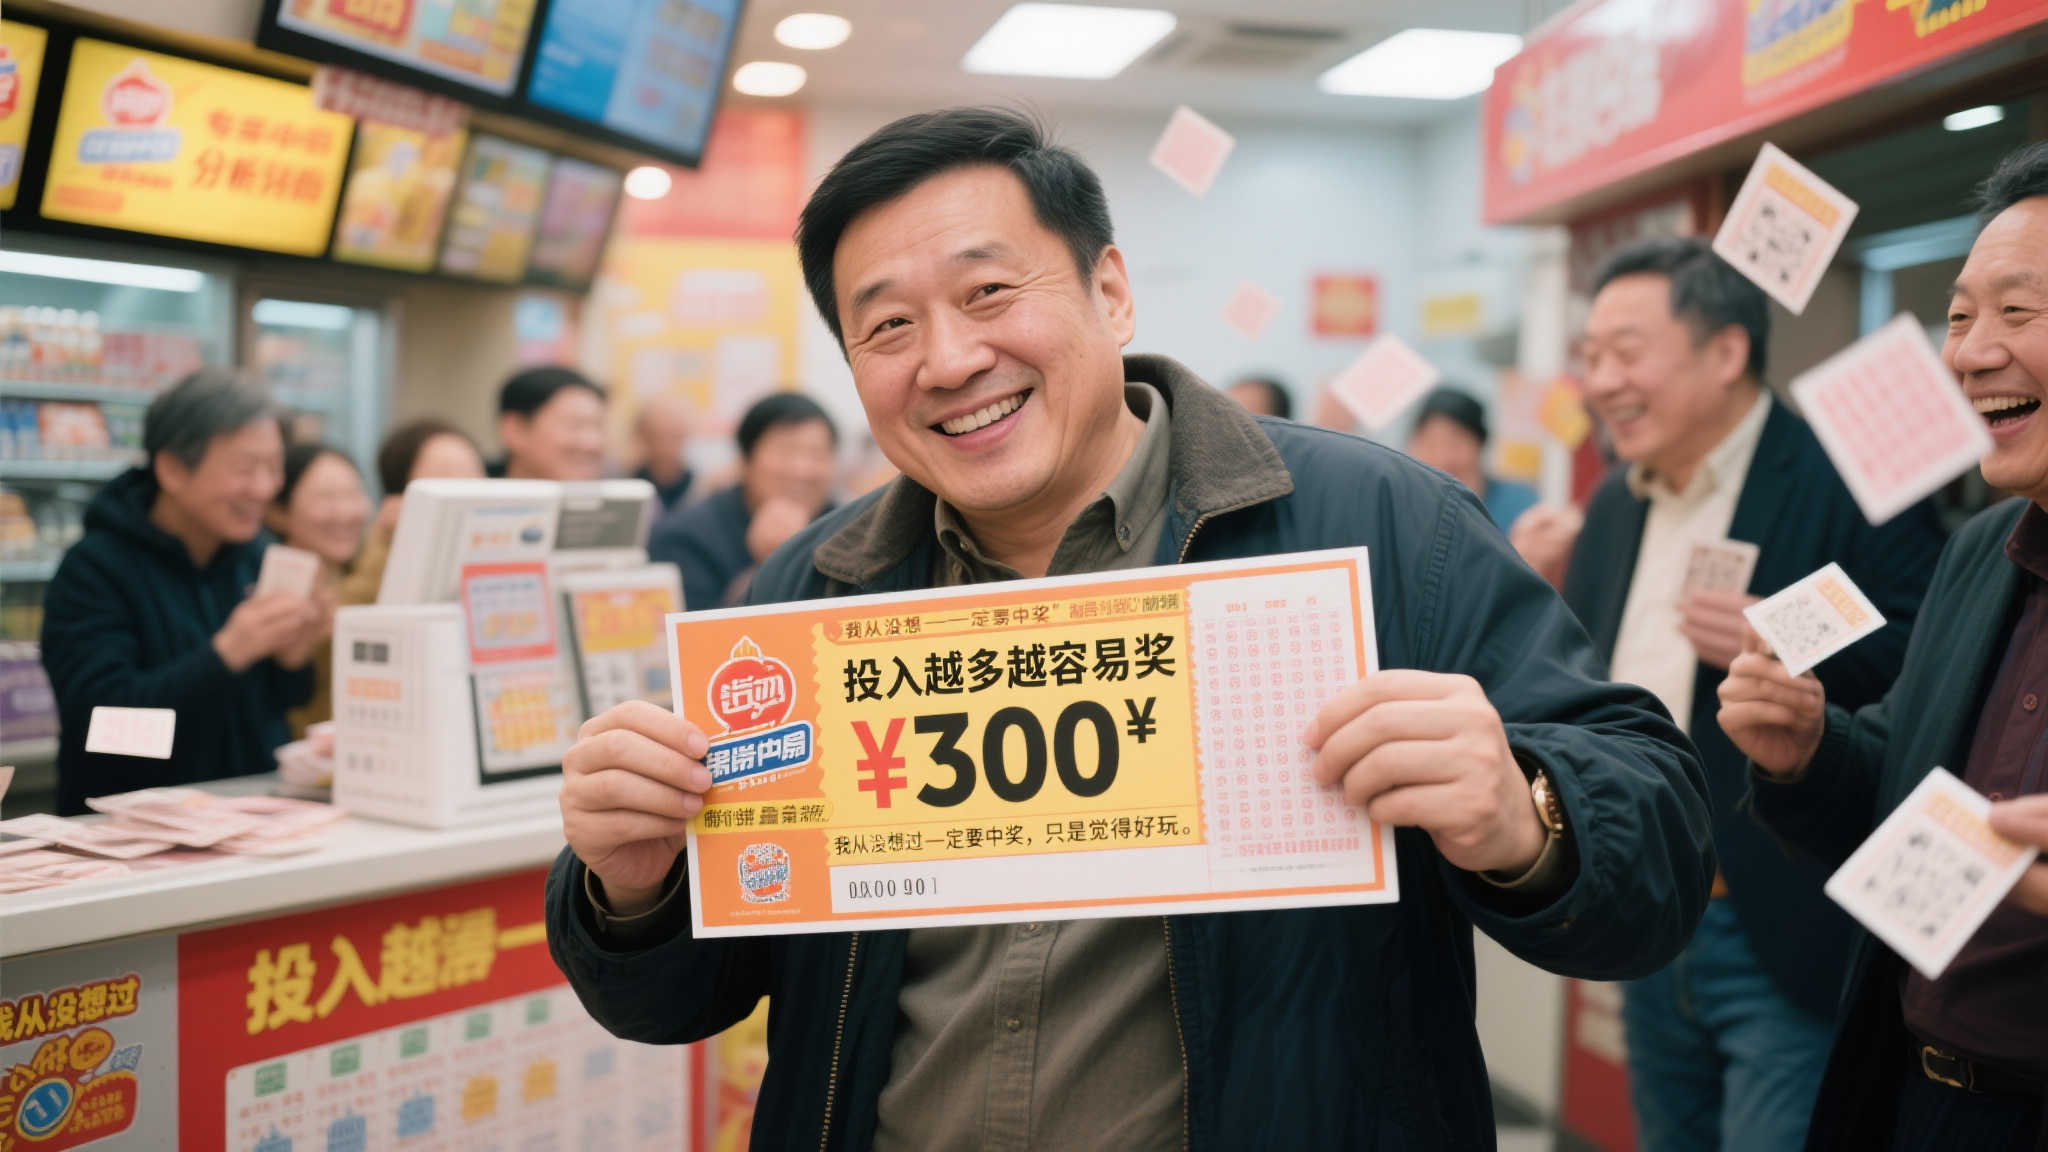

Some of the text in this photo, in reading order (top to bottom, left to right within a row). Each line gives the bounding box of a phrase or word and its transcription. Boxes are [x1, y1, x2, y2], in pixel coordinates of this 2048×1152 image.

[843, 633, 1177, 703] 投入越多越容易奖
